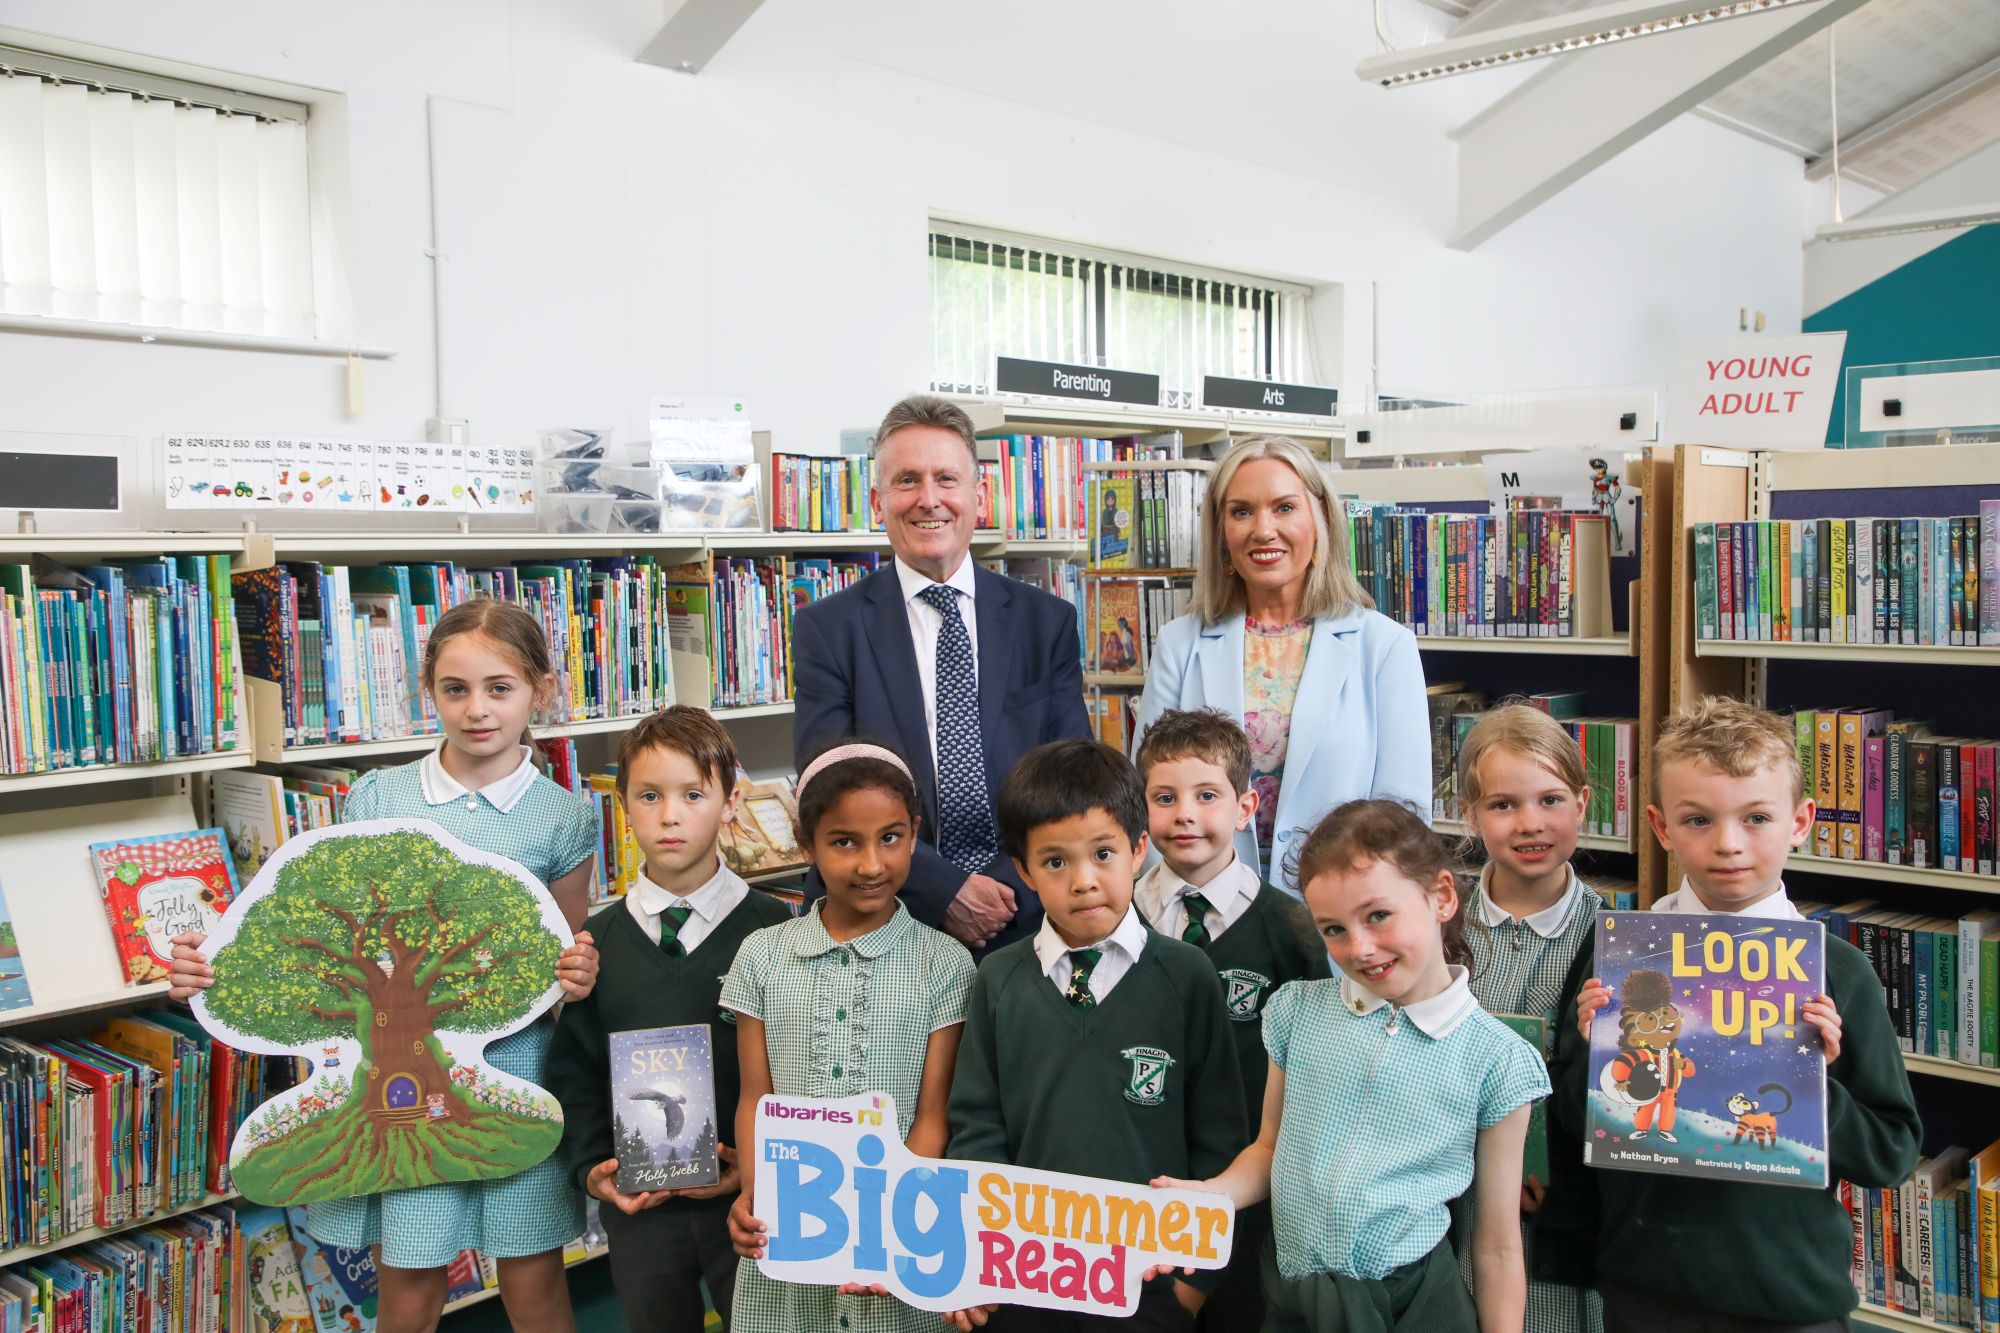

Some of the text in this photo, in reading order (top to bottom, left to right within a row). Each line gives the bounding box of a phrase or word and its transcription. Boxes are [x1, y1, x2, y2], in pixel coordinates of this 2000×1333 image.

[1707, 354, 1812, 380] YOUNG
[1054, 369, 1111, 398] Parenting
[1263, 388, 1284, 406] Arts
[1698, 391, 1804, 416] ADULT
[168, 438, 182, 447] 612
[209, 439, 231, 447] 629.2
[233, 440, 250, 448] 630
[255, 440, 270, 448] 635
[277, 440, 292, 449] 636
[357, 445, 372, 453] 750
[378, 446, 392, 454] 780
[1501, 472, 1520, 488] M
[1735, 540, 1741, 549] OF
[1984, 513, 1996, 556] WATCH
[1832, 526, 1844, 590] GLASGOW BOYS
[1985, 560, 1994, 576] ME
[1458, 562, 1466, 596] PUMPKIN
[1875, 579, 1884, 600] STORM
[1890, 579, 1899, 600] STORM
[1819, 600, 1829, 618] BANG
[1876, 612, 1884, 627] LIES
[1890, 612, 1899, 627] LIES
[1434, 716, 1445, 746] Chain
[1819, 743, 1830, 794] HEARTSTOPPER
[1843, 744, 1855, 796] HEARTSTOPPER
[1890, 734, 1899, 800] GLADIATOR GODDESS
[154, 895, 198, 920] Jolly
[165, 912, 205, 936] Good
[1672, 930, 1809, 982] LOOK
[1939, 937, 1948, 962] DEAD
[1232, 970, 1262, 982] FINAGHY
[1939, 963, 1948, 992] HAPPY
[1234, 983, 1244, 995] P
[1239, 1001, 1248, 1012] S
[1918, 973, 1928, 1031] MY PROBLE
[1711, 989, 1796, 1046] UP!
[631, 1047, 688, 1075] SKY
[1136, 1048, 1167, 1058] FINAGHY
[1139, 1062, 1150, 1075] P
[1145, 1082, 1155, 1094] S
[765, 1102, 854, 1124] libraries
[39, 1132, 48, 1161] gardening
[768, 1142, 799, 1160] The
[1620, 1150, 1652, 1162] Nathan
[1654, 1154, 1679, 1164] Bryon
[634, 1162, 700, 1186] Holly Webb
[1695, 1158, 1800, 1175] illustrated by Dapo Adeola
[764, 1134, 968, 1298] Big
[977, 1172, 1229, 1260] Summer
[1852, 1207, 1861, 1220] WE
[1853, 1221, 1862, 1234] ARE
[1919, 1218, 1930, 1265] CAREERS
[1959, 1249, 1965, 1258] TO
[978, 1230, 1128, 1308] Read
[272, 1280, 300, 1302] FA
